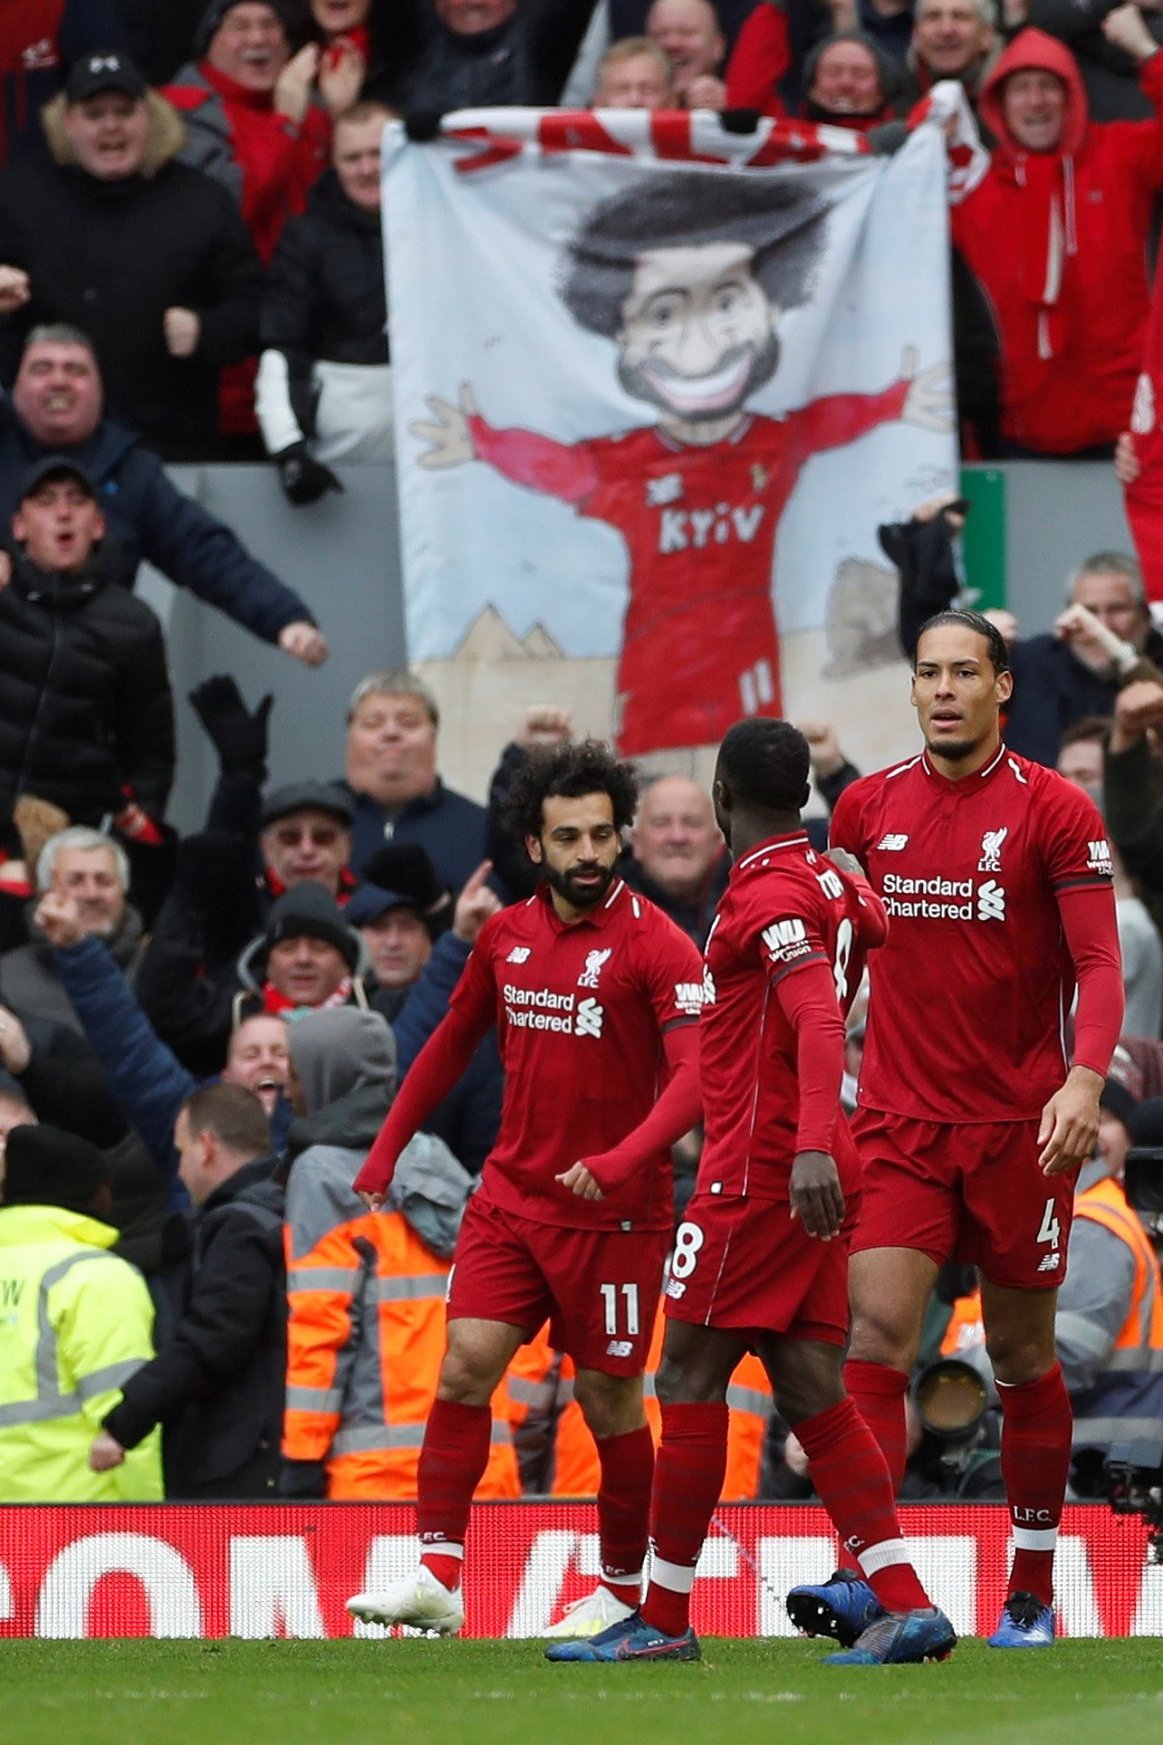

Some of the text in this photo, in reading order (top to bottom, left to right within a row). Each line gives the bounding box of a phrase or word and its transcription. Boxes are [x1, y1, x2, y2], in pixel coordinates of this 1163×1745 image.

[739, 657, 774, 716] 11
[883, 874, 973, 898] Standard
[880, 897, 973, 921] Chartered
[761, 919, 806, 951] WU
[503, 984, 575, 1011] Standard
[1036, 1198, 1061, 1250] 4
[672, 1222, 704, 1278] 8
[600, 1283, 639, 1335] 11
